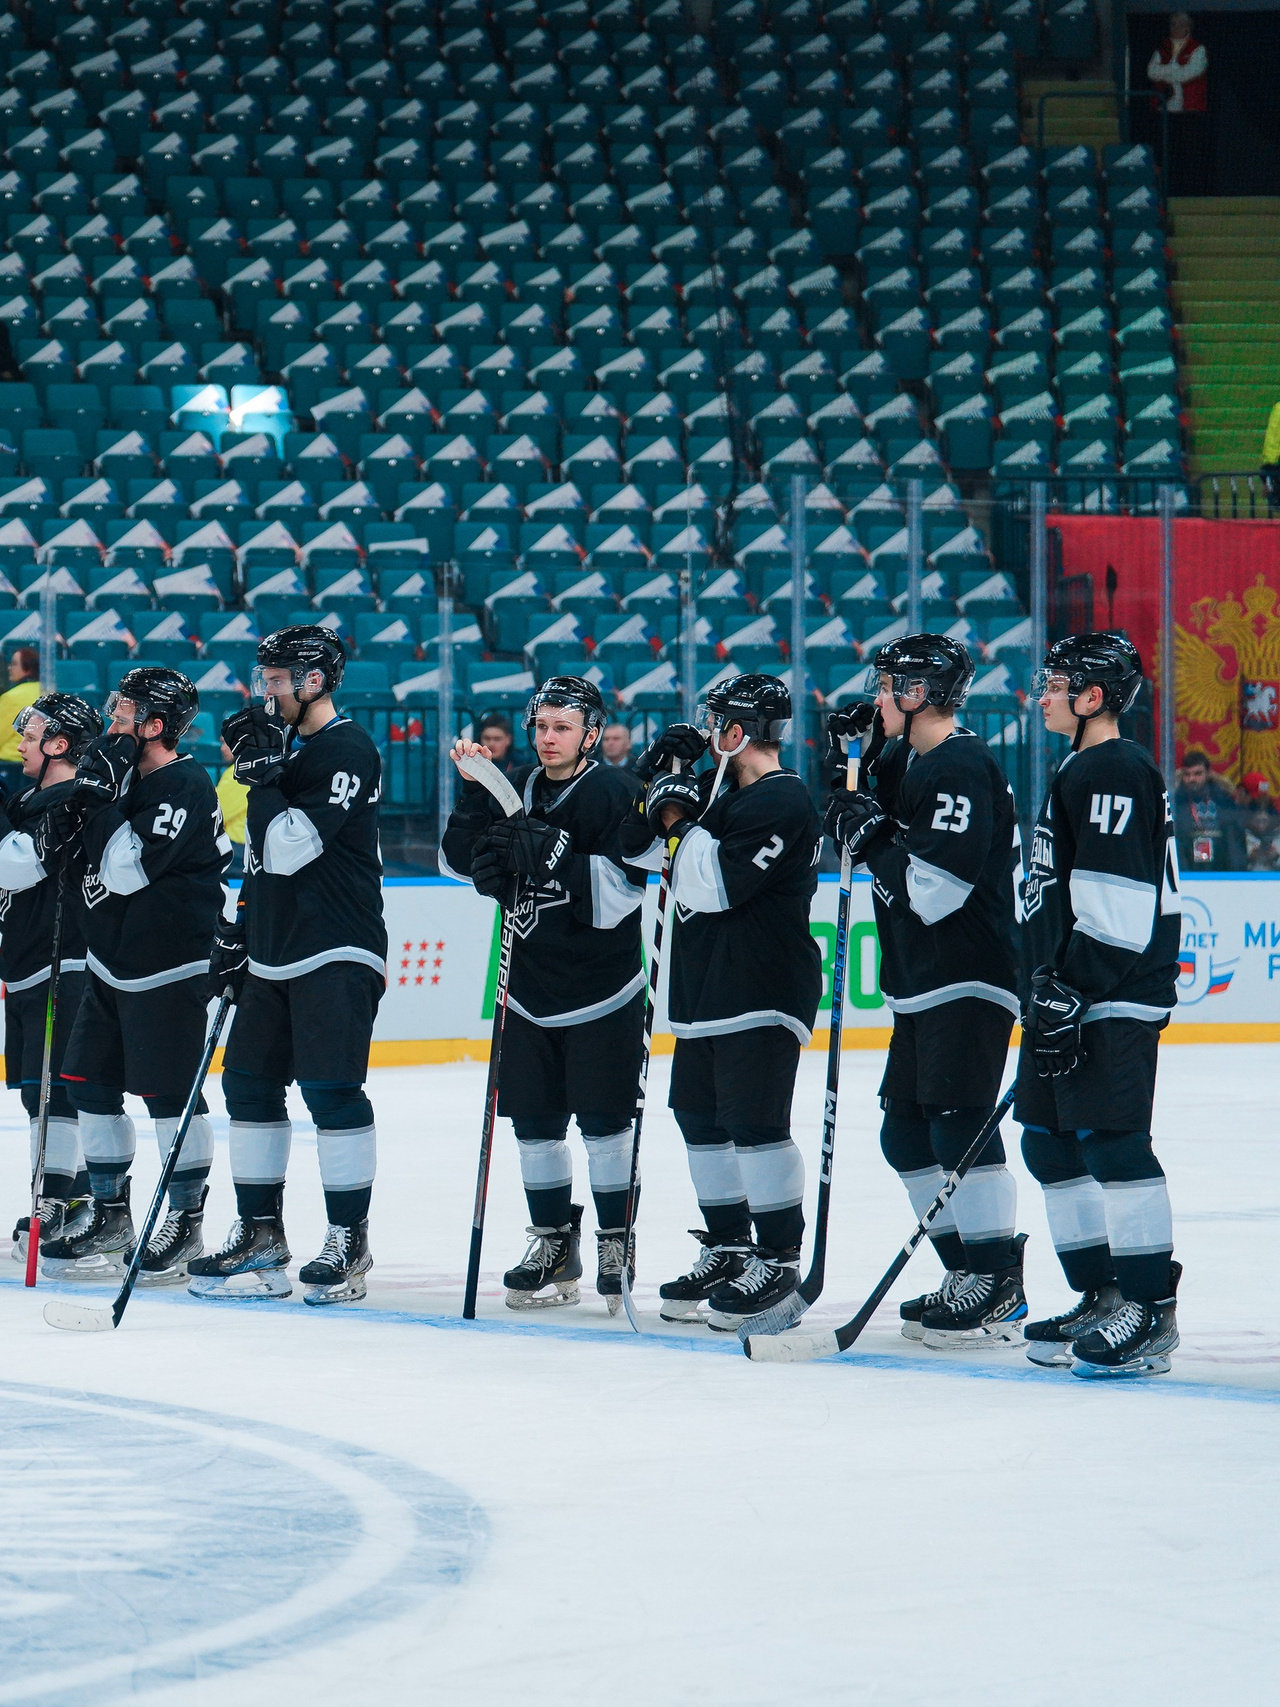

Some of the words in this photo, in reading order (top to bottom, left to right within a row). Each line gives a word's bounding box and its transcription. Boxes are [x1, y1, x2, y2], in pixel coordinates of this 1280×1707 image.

[727, 699, 755, 709] BAUER
[328, 771, 361, 811] 92
[152, 803, 187, 839] 29
[931, 792, 971, 834] 23
[1089, 793, 1133, 835] 47
[751, 834, 784, 871] 2
[820, 1089, 837, 1185] CCM
[904, 1171, 962, 1256] CCM
[980, 1292, 1018, 1326] CCM
